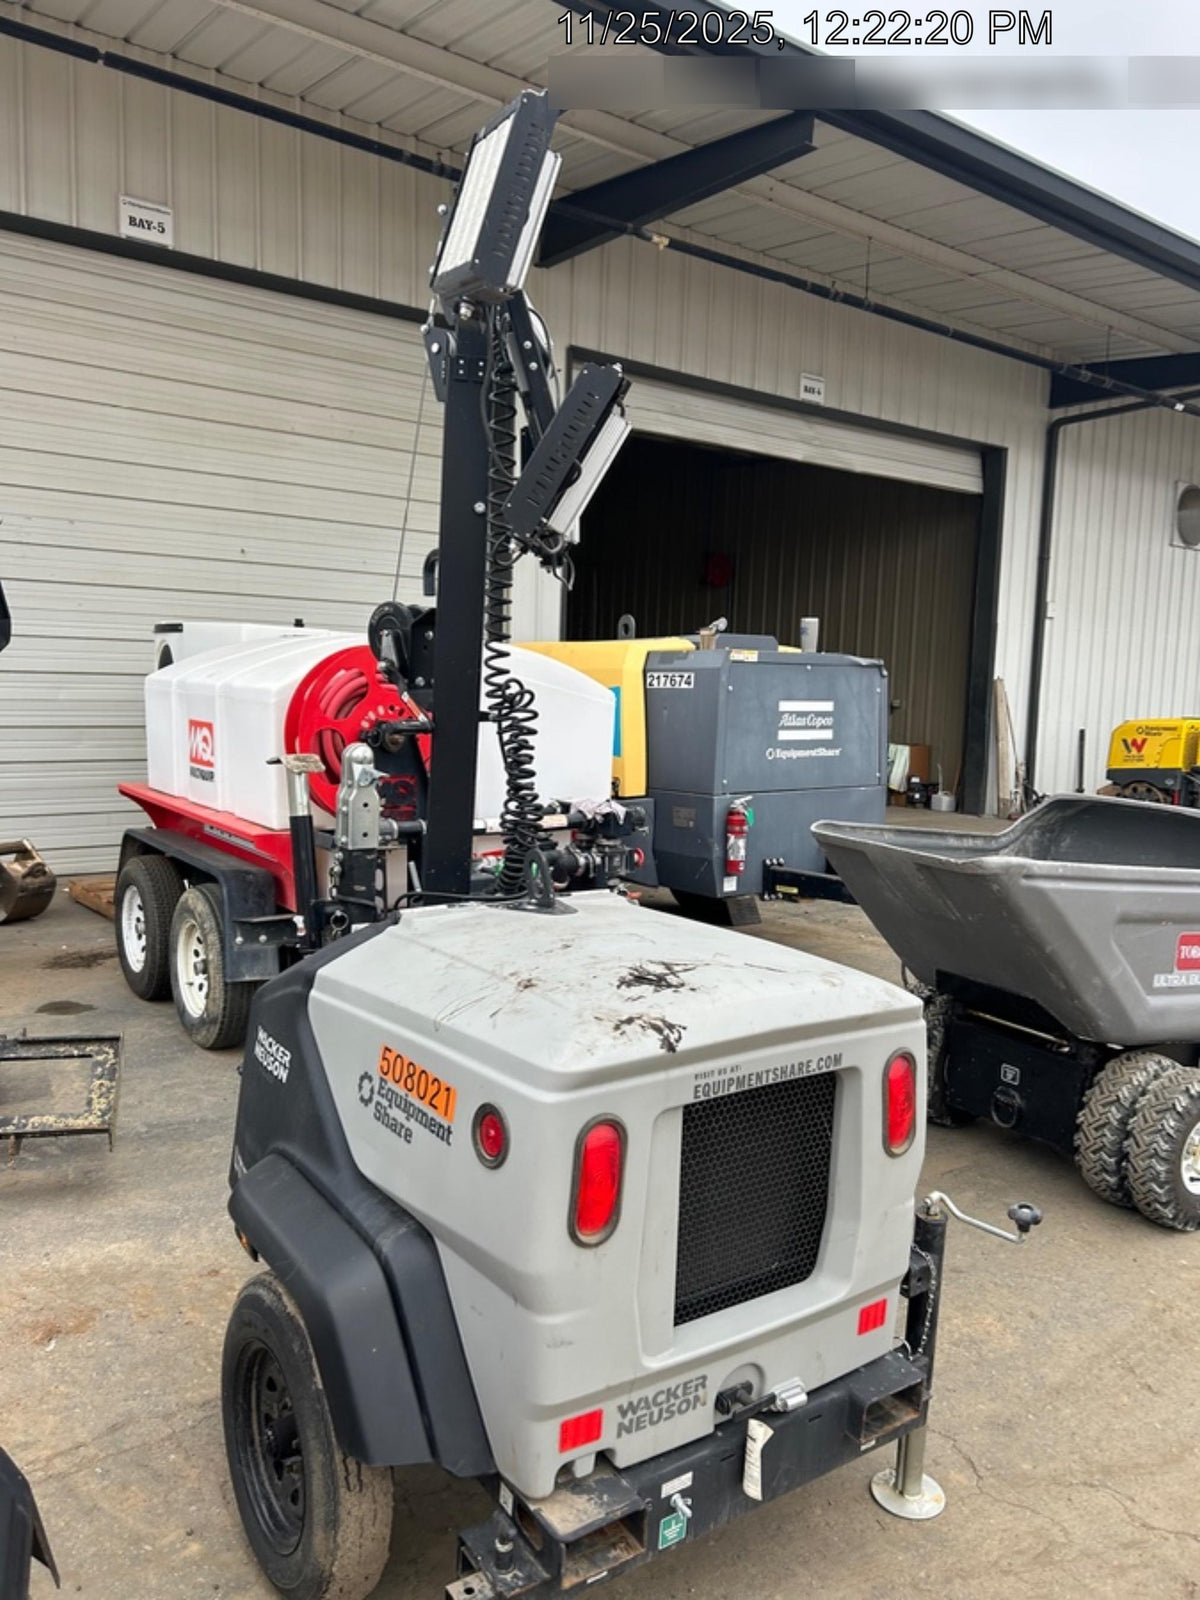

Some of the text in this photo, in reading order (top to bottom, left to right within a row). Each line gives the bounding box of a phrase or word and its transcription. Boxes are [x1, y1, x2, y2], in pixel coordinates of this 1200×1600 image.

[128, 215, 166, 234] BAY-5
[648, 673, 692, 688] 217674
[254, 1040, 289, 1083] NEUSON
[257, 1025, 291, 1068] WACKER
[380, 1045, 452, 1117] 508021
[693, 1052, 843, 1100] EQUIPMENTSHARE.COM
[373, 1100, 413, 1144] Share
[377, 1077, 453, 1146] Equipment
[616, 1374, 708, 1420] WACKER
[616, 1394, 707, 1439] NEUSON
